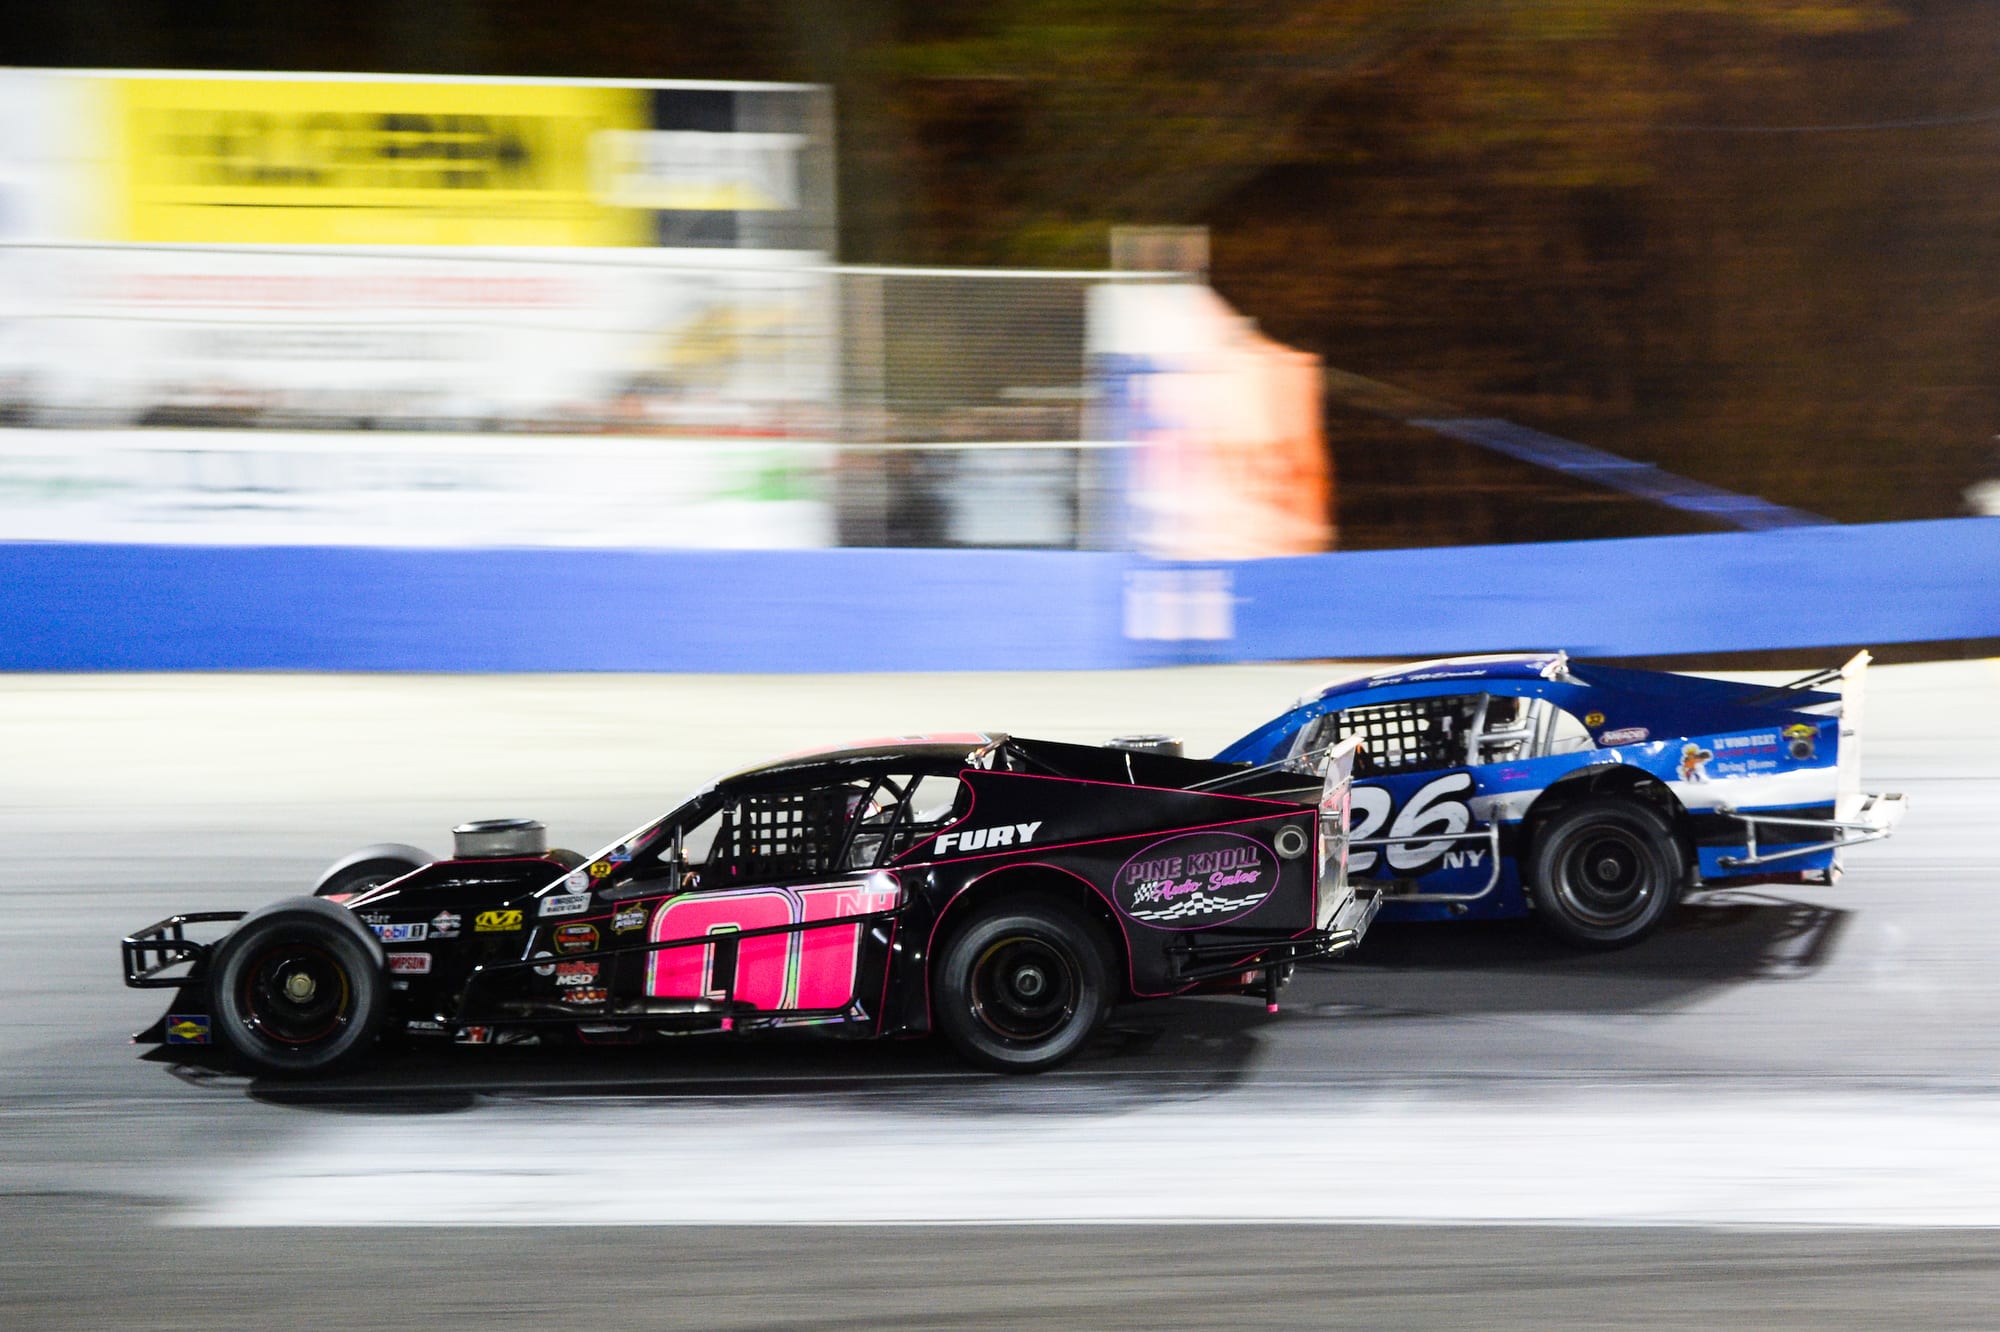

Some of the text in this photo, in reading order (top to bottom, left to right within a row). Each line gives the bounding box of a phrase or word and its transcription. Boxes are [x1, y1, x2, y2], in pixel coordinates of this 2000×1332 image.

[934, 821, 1043, 855] FURY
[1348, 772, 1473, 873] 26
[1125, 846, 1261, 885] PINE KNOLL
[1442, 850, 1486, 870] NY
[1152, 870, 1262, 900] Auto Sales
[556, 974, 594, 985] MSD
